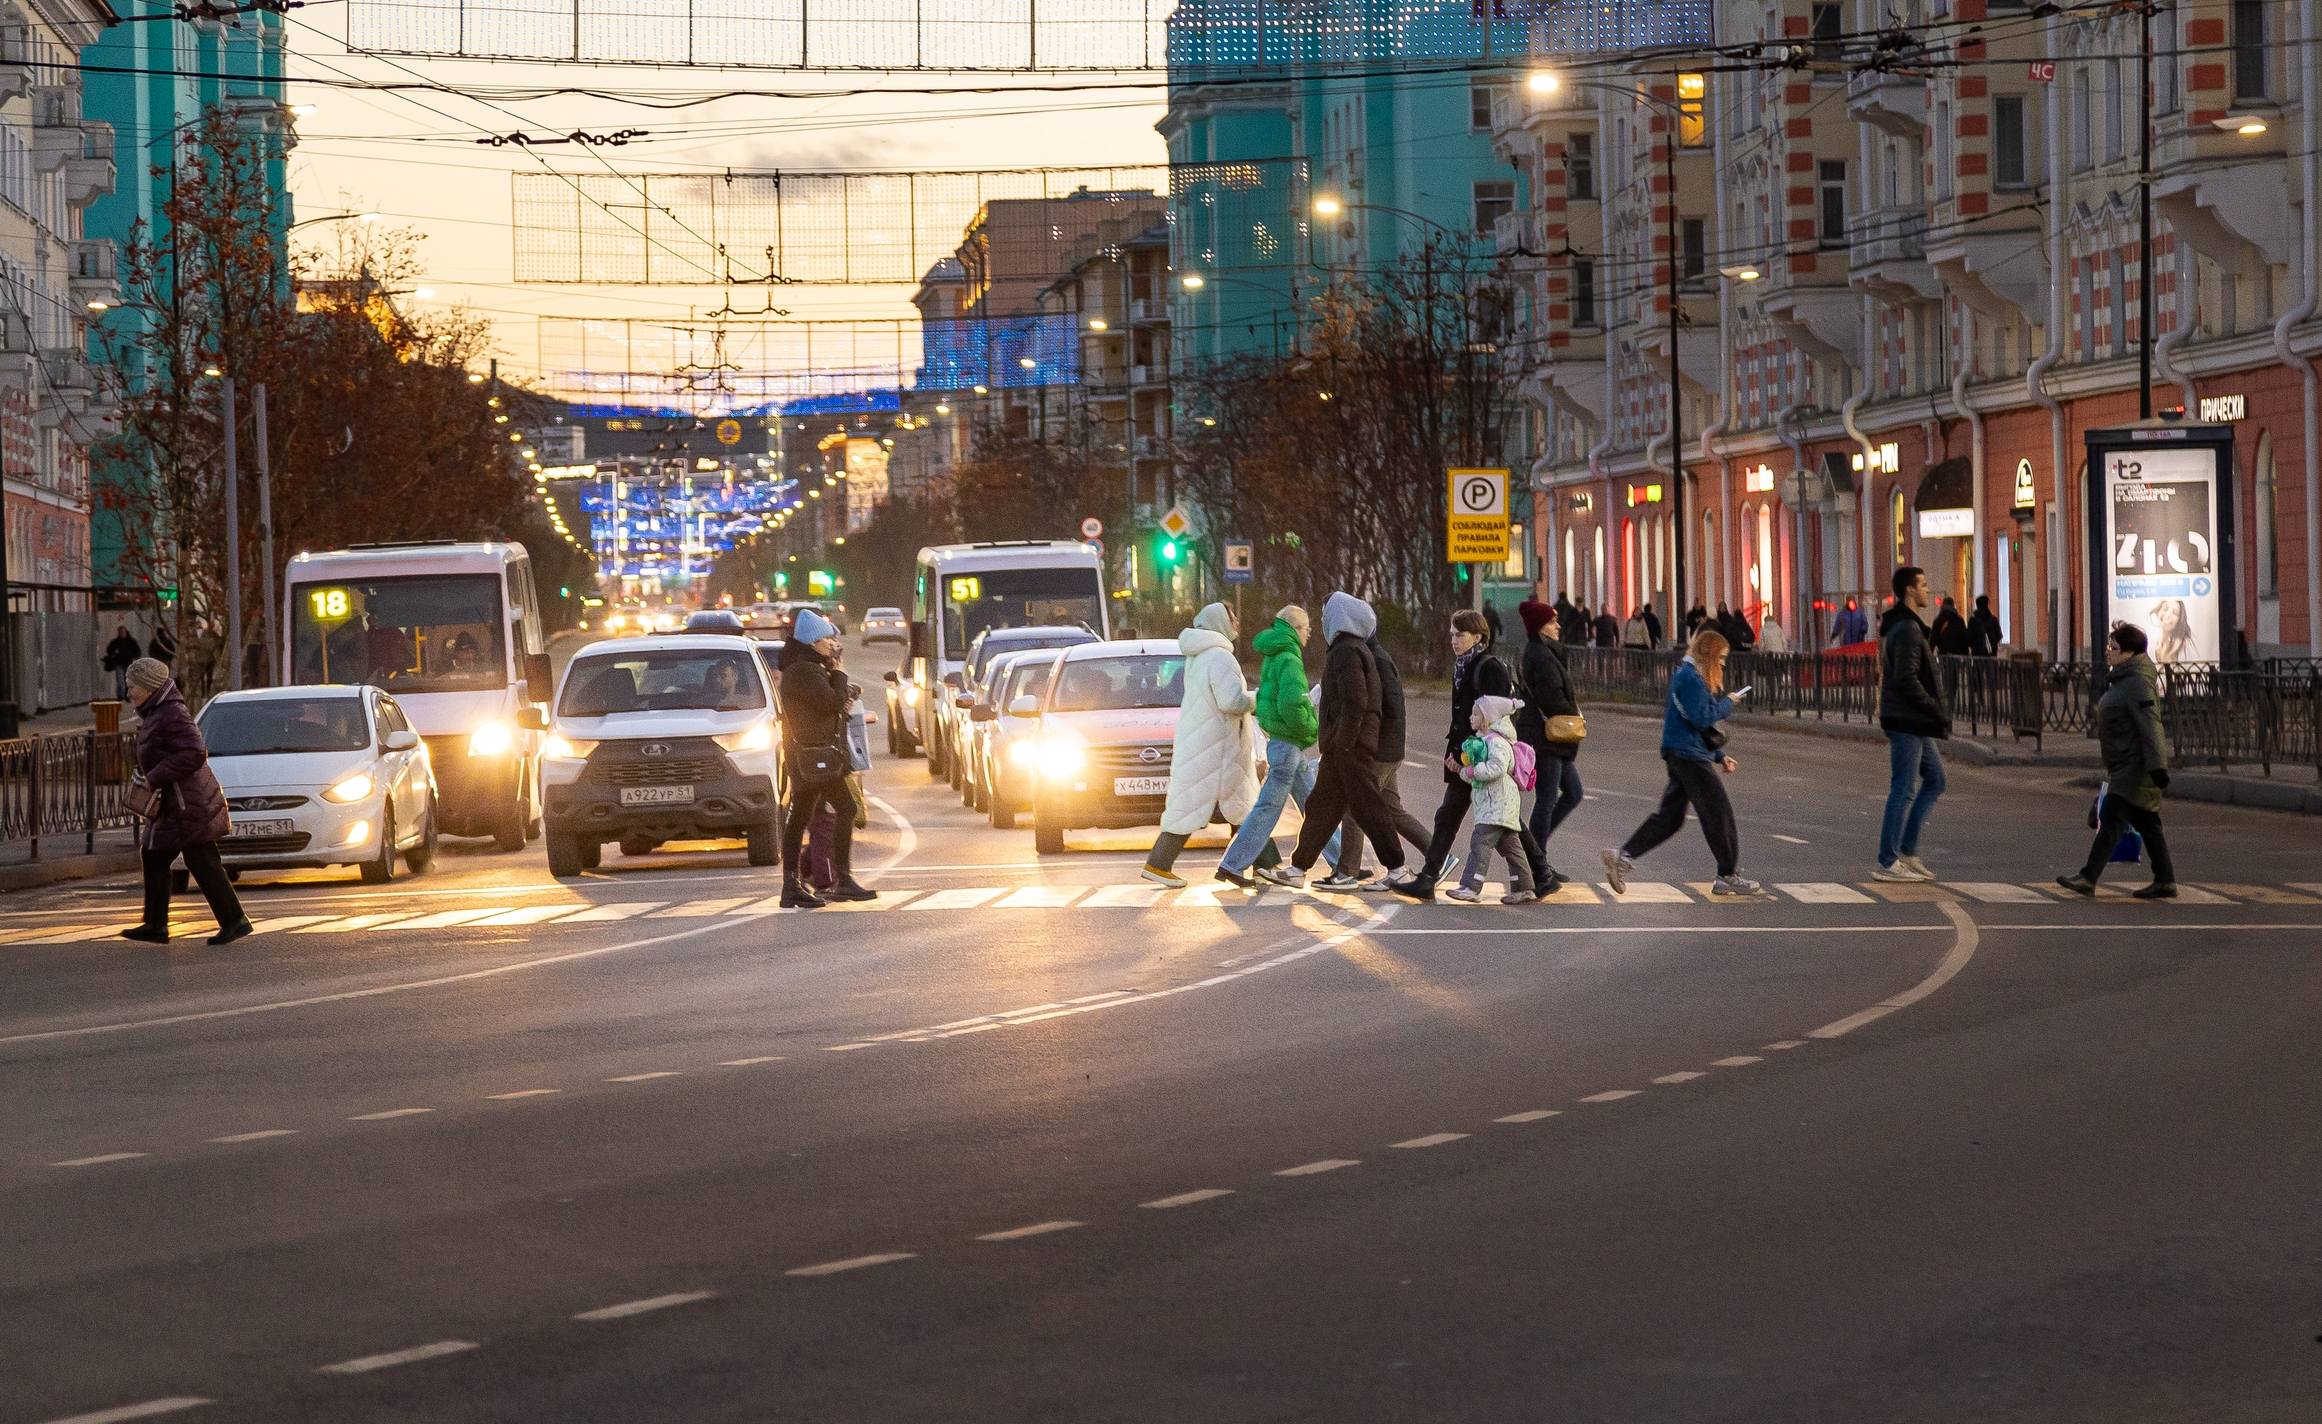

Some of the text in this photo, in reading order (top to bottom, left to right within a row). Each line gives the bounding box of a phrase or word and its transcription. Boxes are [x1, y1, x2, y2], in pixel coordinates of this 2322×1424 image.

[2201, 394, 2244, 422] ПРИЧЕСКИ
[2118, 459, 2142, 480] t2
[1453, 521, 1506, 531] СОБЛЮДАЙ
[1457, 534, 1501, 542] ПРАВИЛА
[1454, 545, 1504, 553] ПАРКОВКИ
[952, 578, 979, 600] 51
[311, 590, 348, 618] 18
[626, 786, 691, 801] А922УР 51
[231, 821, 290, 836] 712МЕ 51
